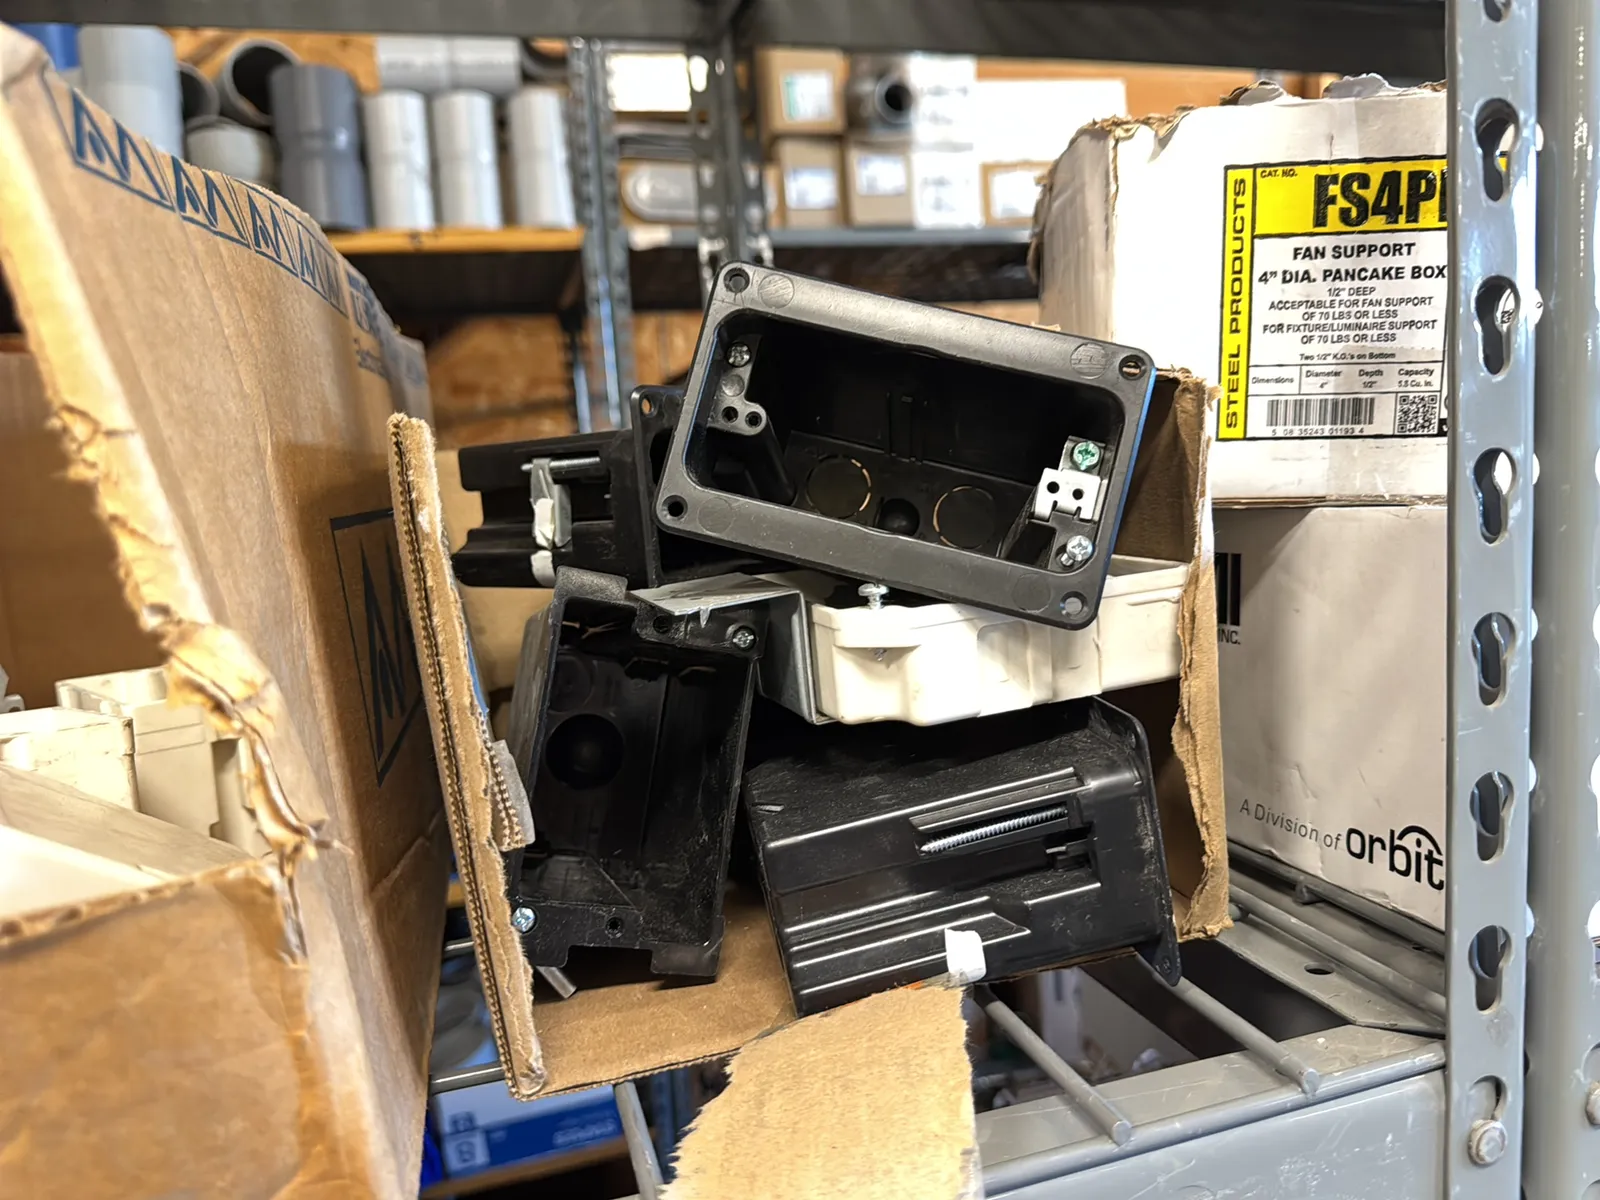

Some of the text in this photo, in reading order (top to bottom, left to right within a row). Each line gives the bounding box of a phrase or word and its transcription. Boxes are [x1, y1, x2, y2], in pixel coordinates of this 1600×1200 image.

[1260, 168, 1298, 178] CAT. NO.
[1292, 242, 1416, 261] FAN SUPPORT
[1281, 269, 1317, 284] DIA.
[1322, 265, 1406, 282] PANCAKE
[1411, 264, 1447, 280] BOX
[1327, 286, 1376, 297] 1/2" DEEP
[1226, 178, 1247, 429] STEEL PRODUCTS
[1268, 296, 1434, 311] ACCEPTABLE FOR FAN SUPPORT
[1301, 309, 1398, 321] OF 70 LBS OR LESS
[1262, 319, 1438, 334] FOR FIXTURE/LUMINAIRE SUPPORT
[1300, 332, 1397, 345] OF 70 LBS OR LESS
[1299, 353, 1315, 361] Two
[1368, 352, 1396, 360] Bottom
[1305, 368, 1435, 378] Diameter Depth Capacity
[1251, 376, 1295, 385] Dimensions
[1297, 427, 1325, 437] 35243
[1328, 426, 1355, 436] 01193
[1239, 798, 1250, 816] A
[1254, 803, 1320, 843] Division
[1323, 833, 1343, 850] of
